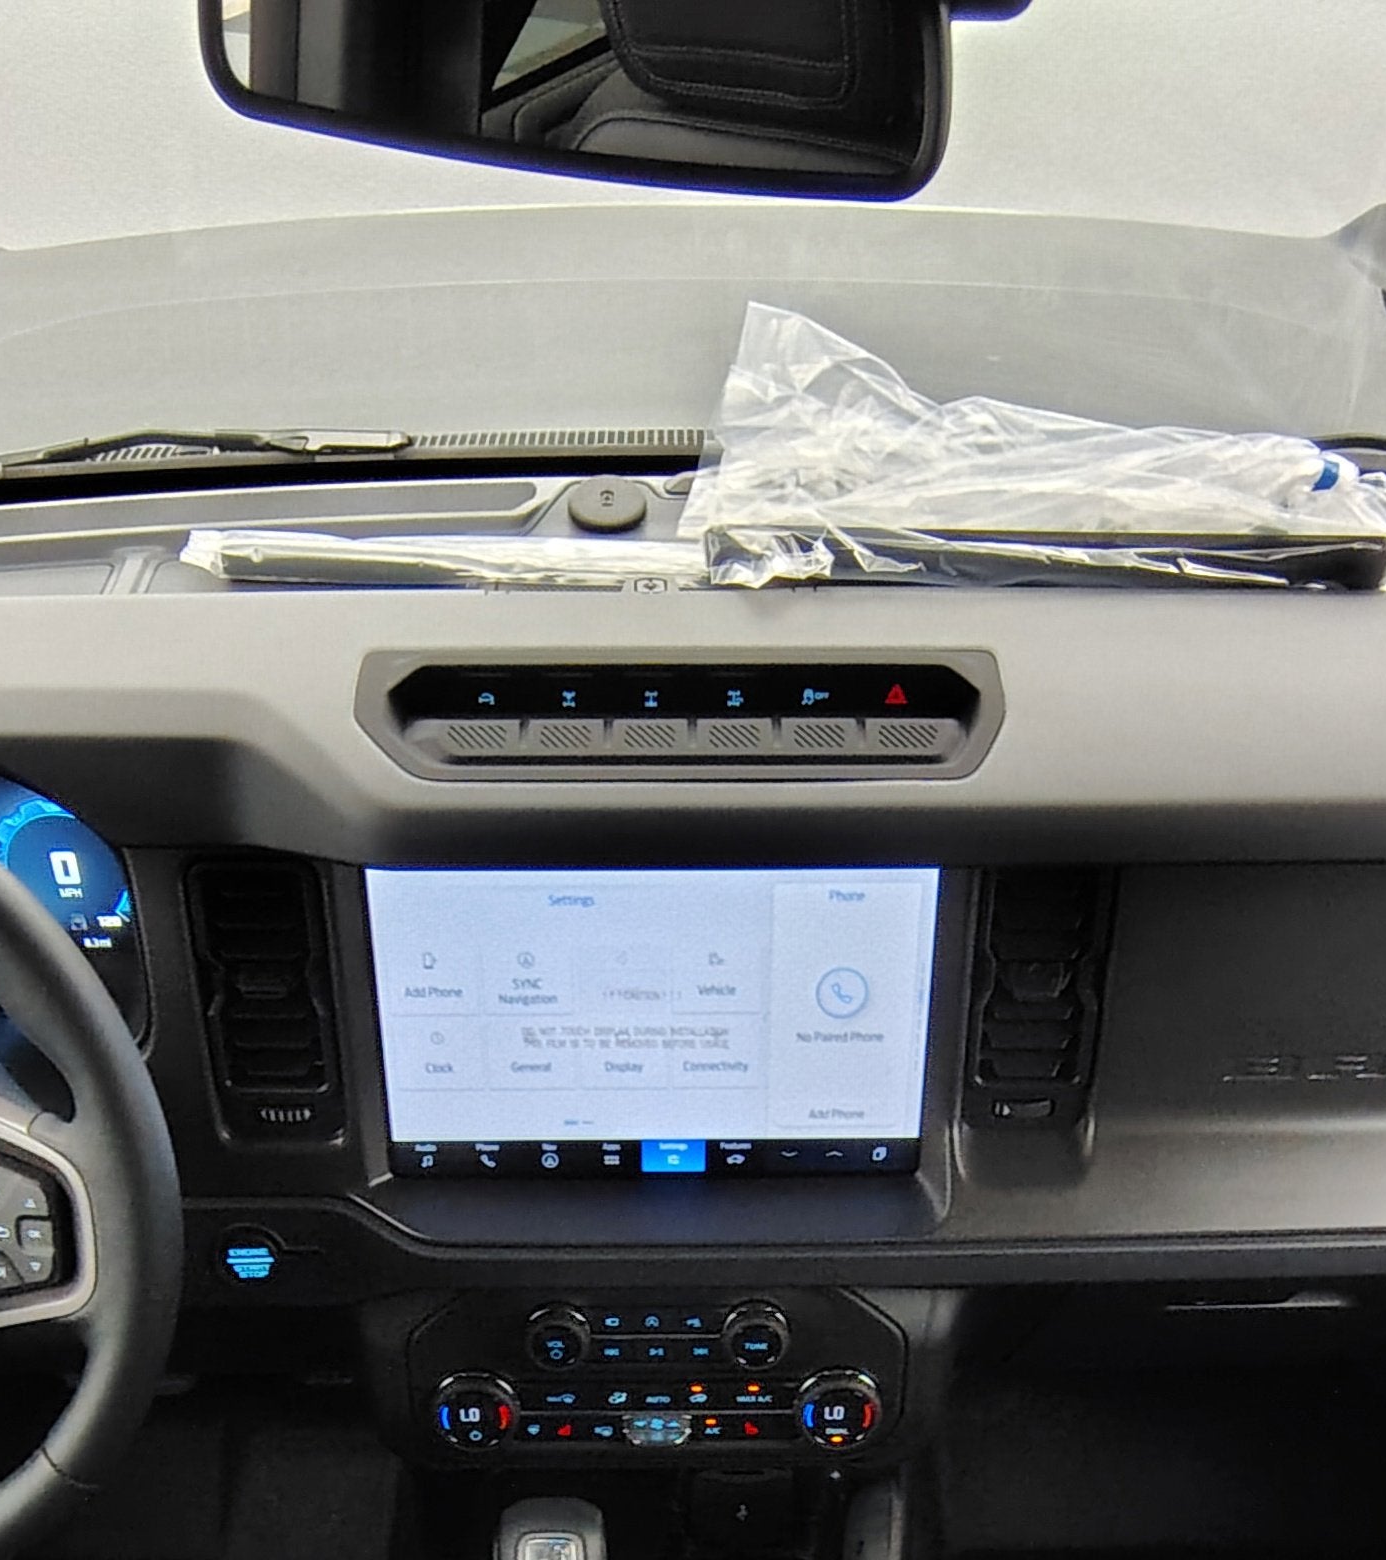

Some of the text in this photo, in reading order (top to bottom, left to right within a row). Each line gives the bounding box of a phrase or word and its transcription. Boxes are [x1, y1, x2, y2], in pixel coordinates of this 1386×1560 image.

[49, 850, 82, 885] 0
[59, 888, 83, 898] MPH
[829, 890, 865, 900] Phone
[548, 895, 595, 907] Settings
[512, 978, 542, 989] SYNC
[404, 987, 463, 998] Add Phone
[697, 985, 736, 996] Vehicle
[499, 994, 558, 1006] Navigation
[796, 1031, 884, 1042] No Paired Phone
[425, 1063, 454, 1073] Clock
[511, 1062, 551, 1072] General
[605, 1062, 643, 1073] Display
[683, 1061, 749, 1072] Connectivity
[809, 1109, 865, 1119] Add Phone
